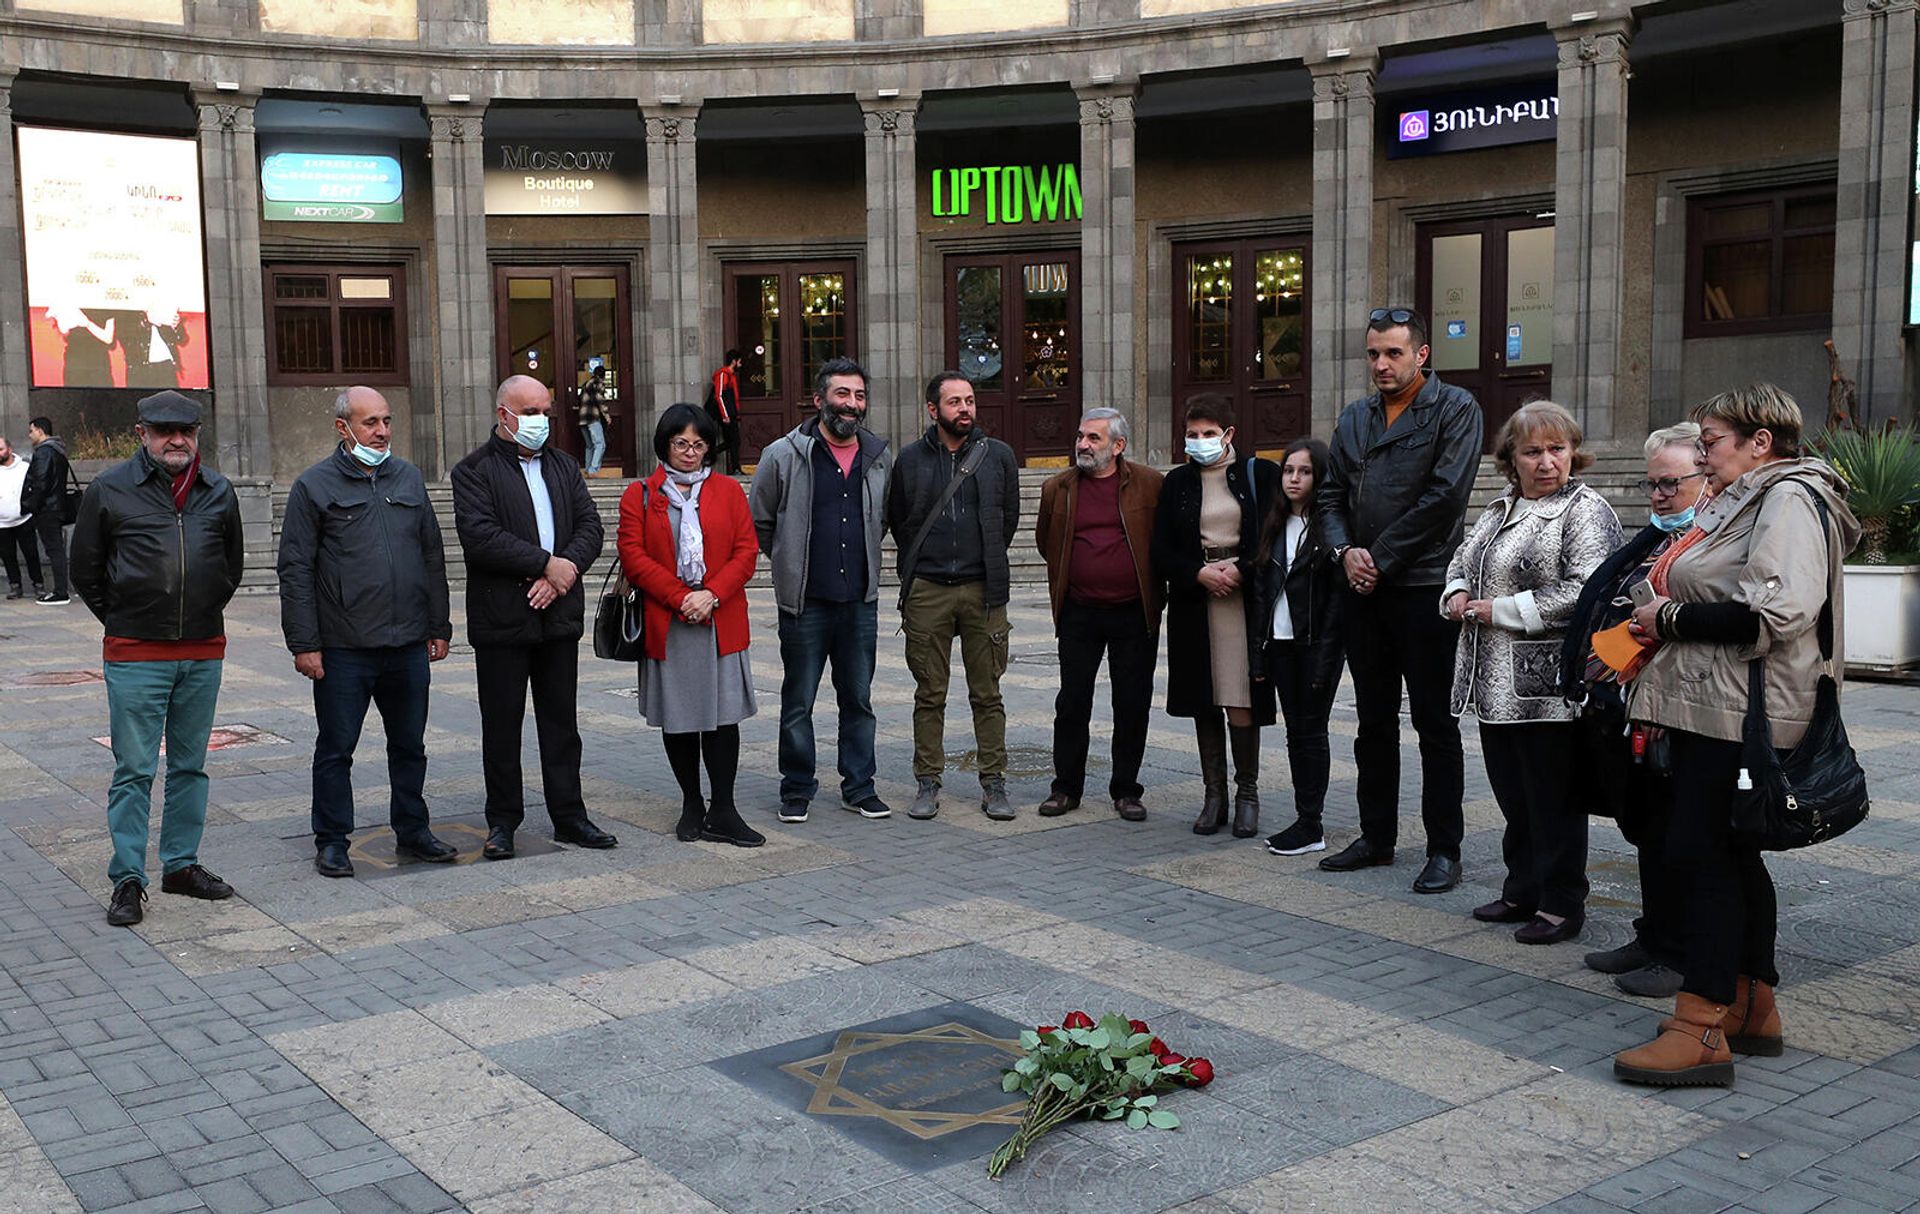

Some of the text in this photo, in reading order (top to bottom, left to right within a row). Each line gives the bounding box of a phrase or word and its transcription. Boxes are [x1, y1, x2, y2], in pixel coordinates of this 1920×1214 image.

[524, 176, 594, 192] Boutique
[540, 195, 579, 208] Hotel
[932, 163, 1082, 224] UPTOWN
